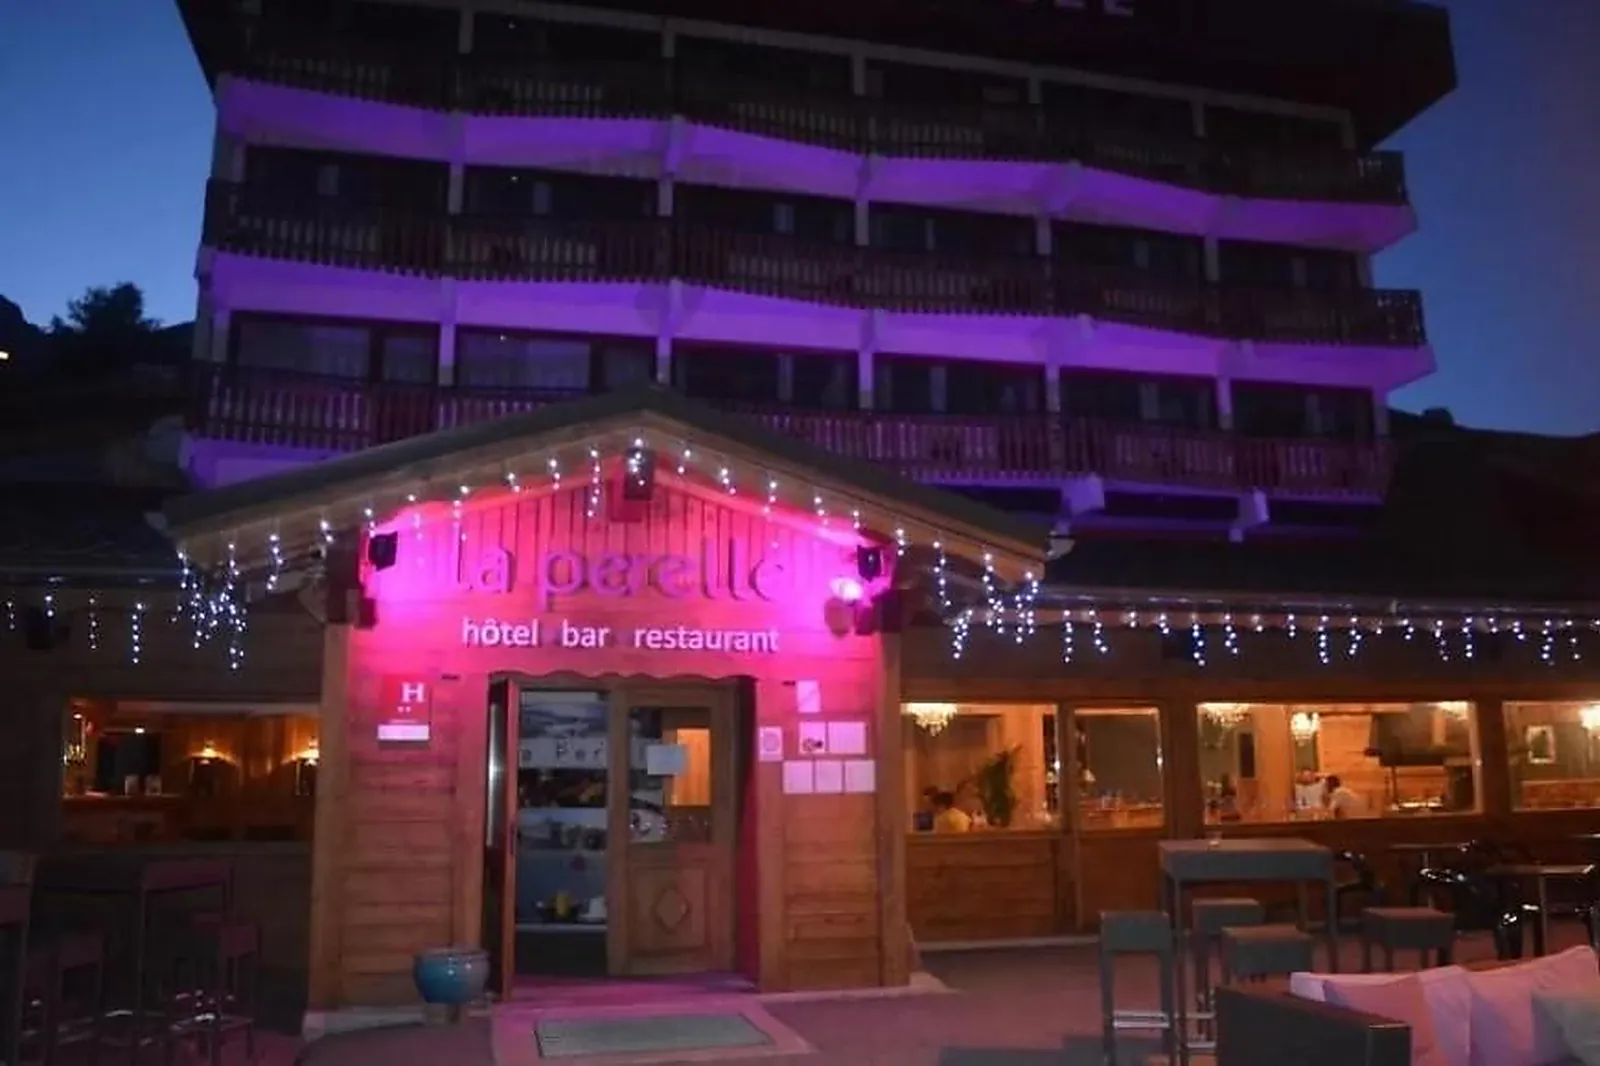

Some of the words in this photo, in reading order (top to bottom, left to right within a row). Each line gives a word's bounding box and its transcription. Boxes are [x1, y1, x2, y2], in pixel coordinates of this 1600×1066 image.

[543, 536, 785, 612] perelle
[461, 617, 539, 647] hôtel
[561, 619, 610, 648] bar
[633, 623, 780, 653] restaurant
[402, 681, 425, 703] H
